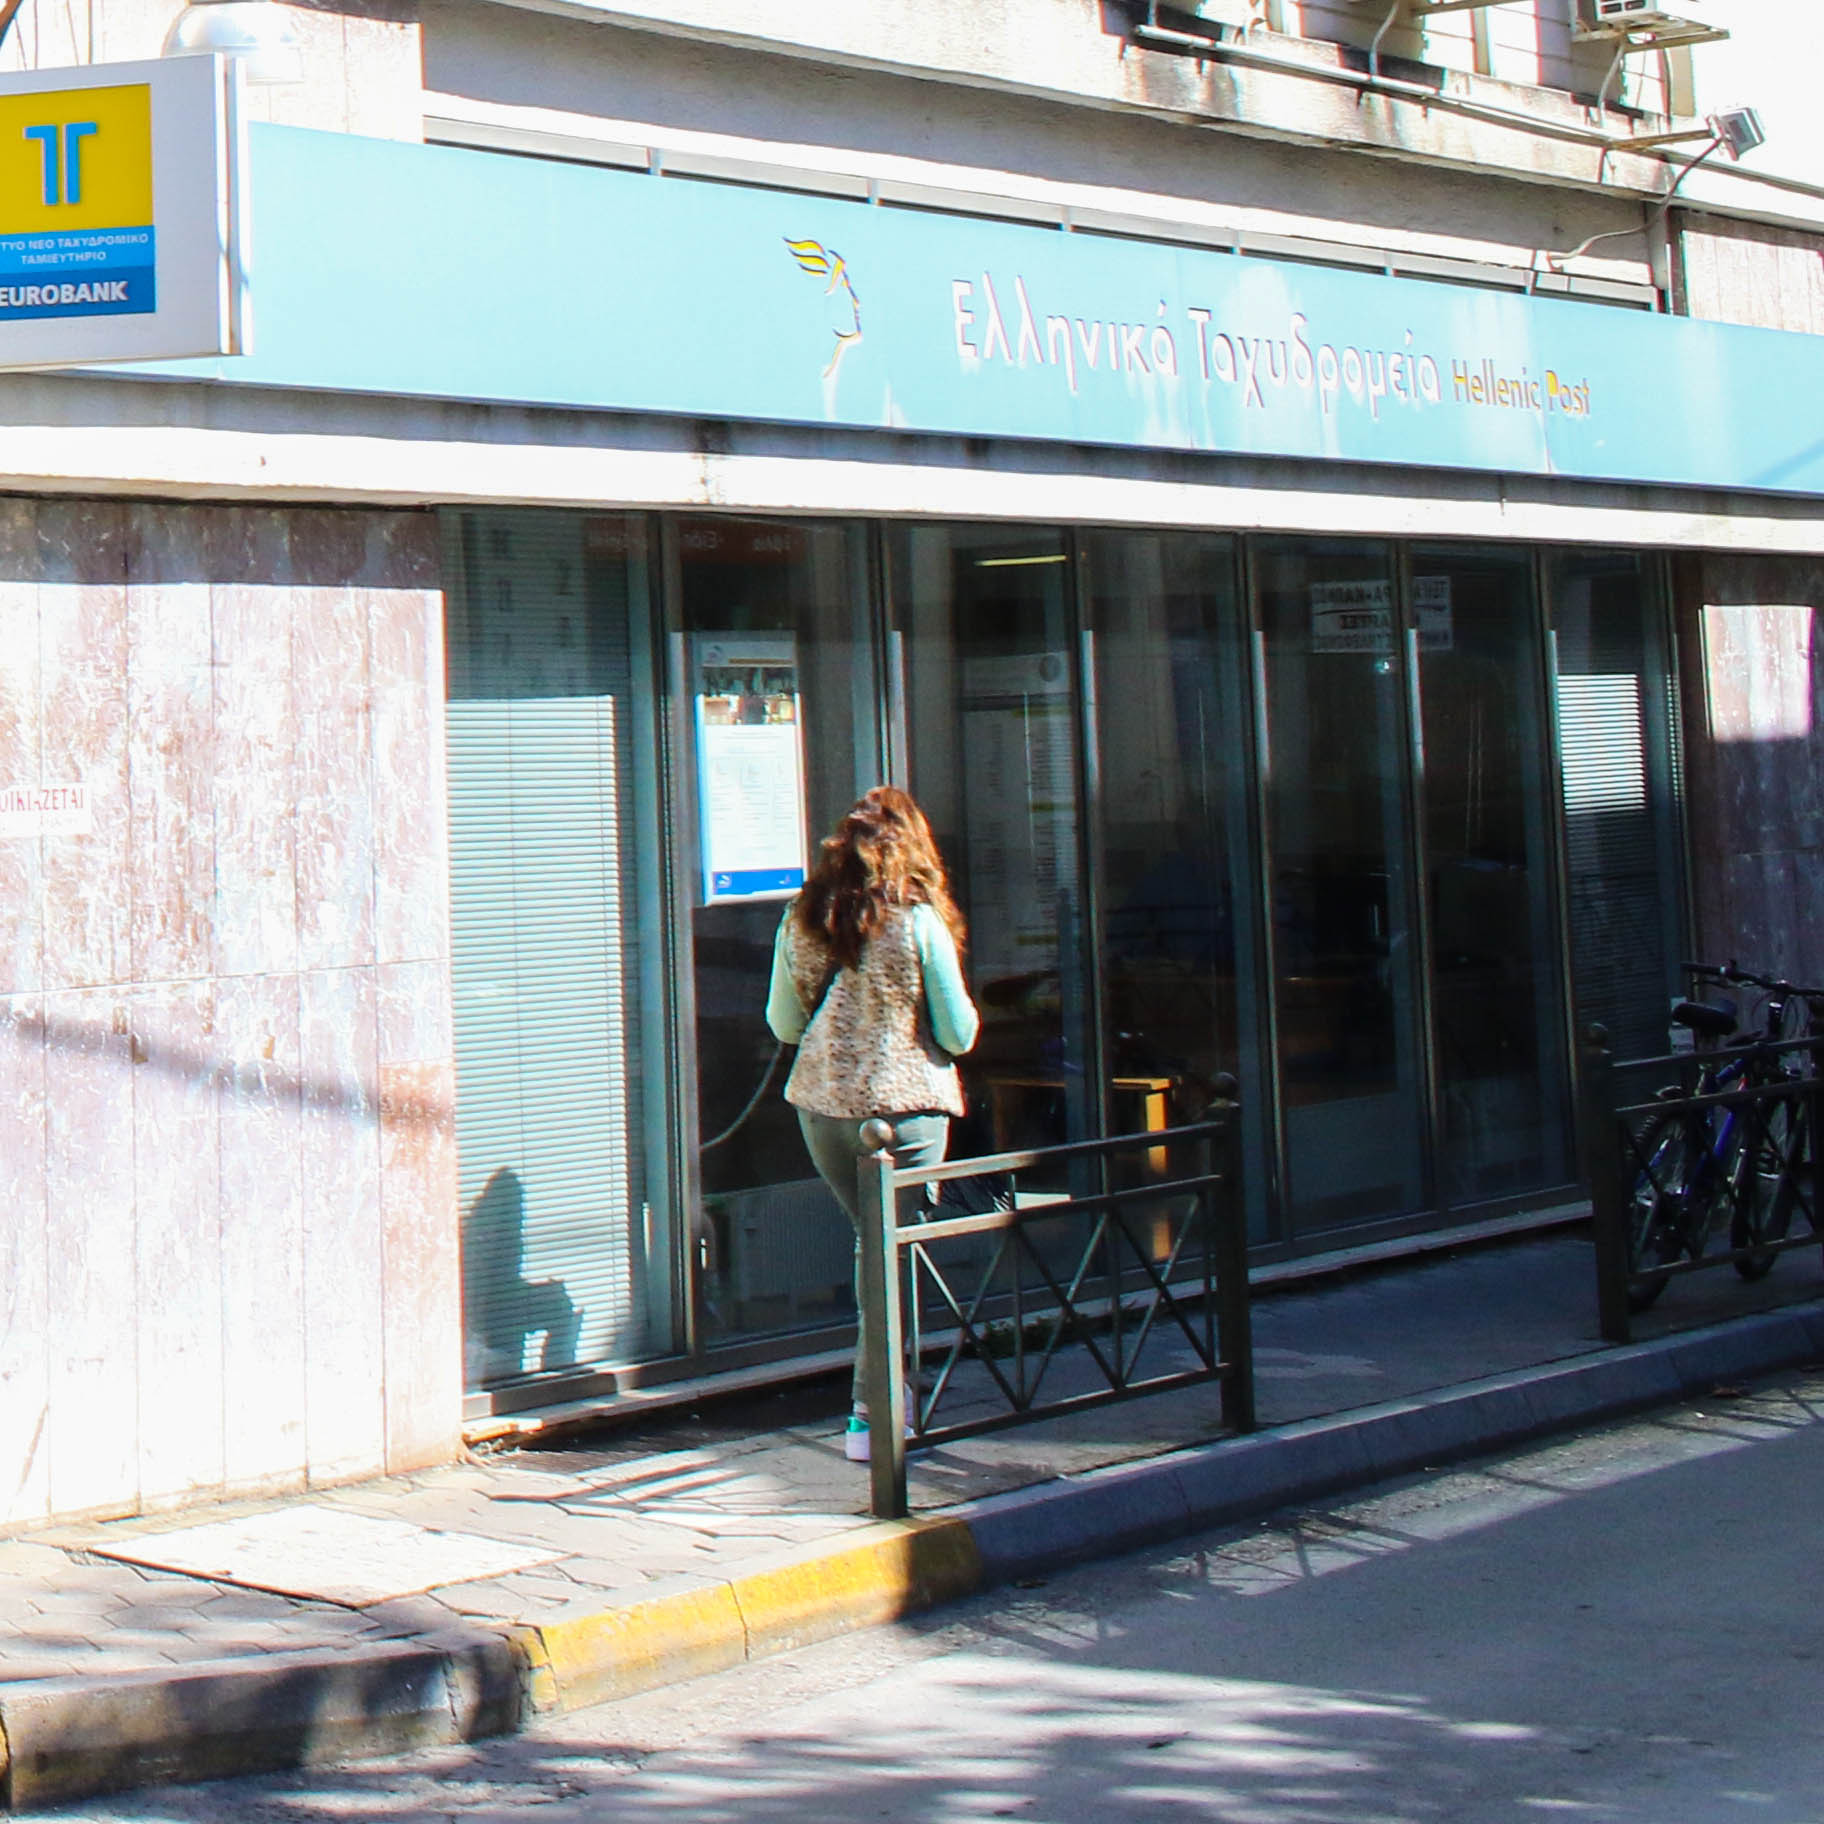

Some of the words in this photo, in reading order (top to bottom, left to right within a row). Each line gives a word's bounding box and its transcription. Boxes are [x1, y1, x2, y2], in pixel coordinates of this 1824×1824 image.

[20, 251, 107, 265] ΤΑΜΙΕΥΤΗΡΙΟ
[28, 238, 56, 251] ΝΕΟ
[57, 233, 149, 249] ΤΑΧΥΔΡΟΜΙΚΟ
[951, 270, 1178, 391] Ελληνικά
[1188, 307, 1442, 418] Ταχυδρομεία
[1452, 358, 1541, 411] Hellenic
[1544, 369, 1591, 415] Post
